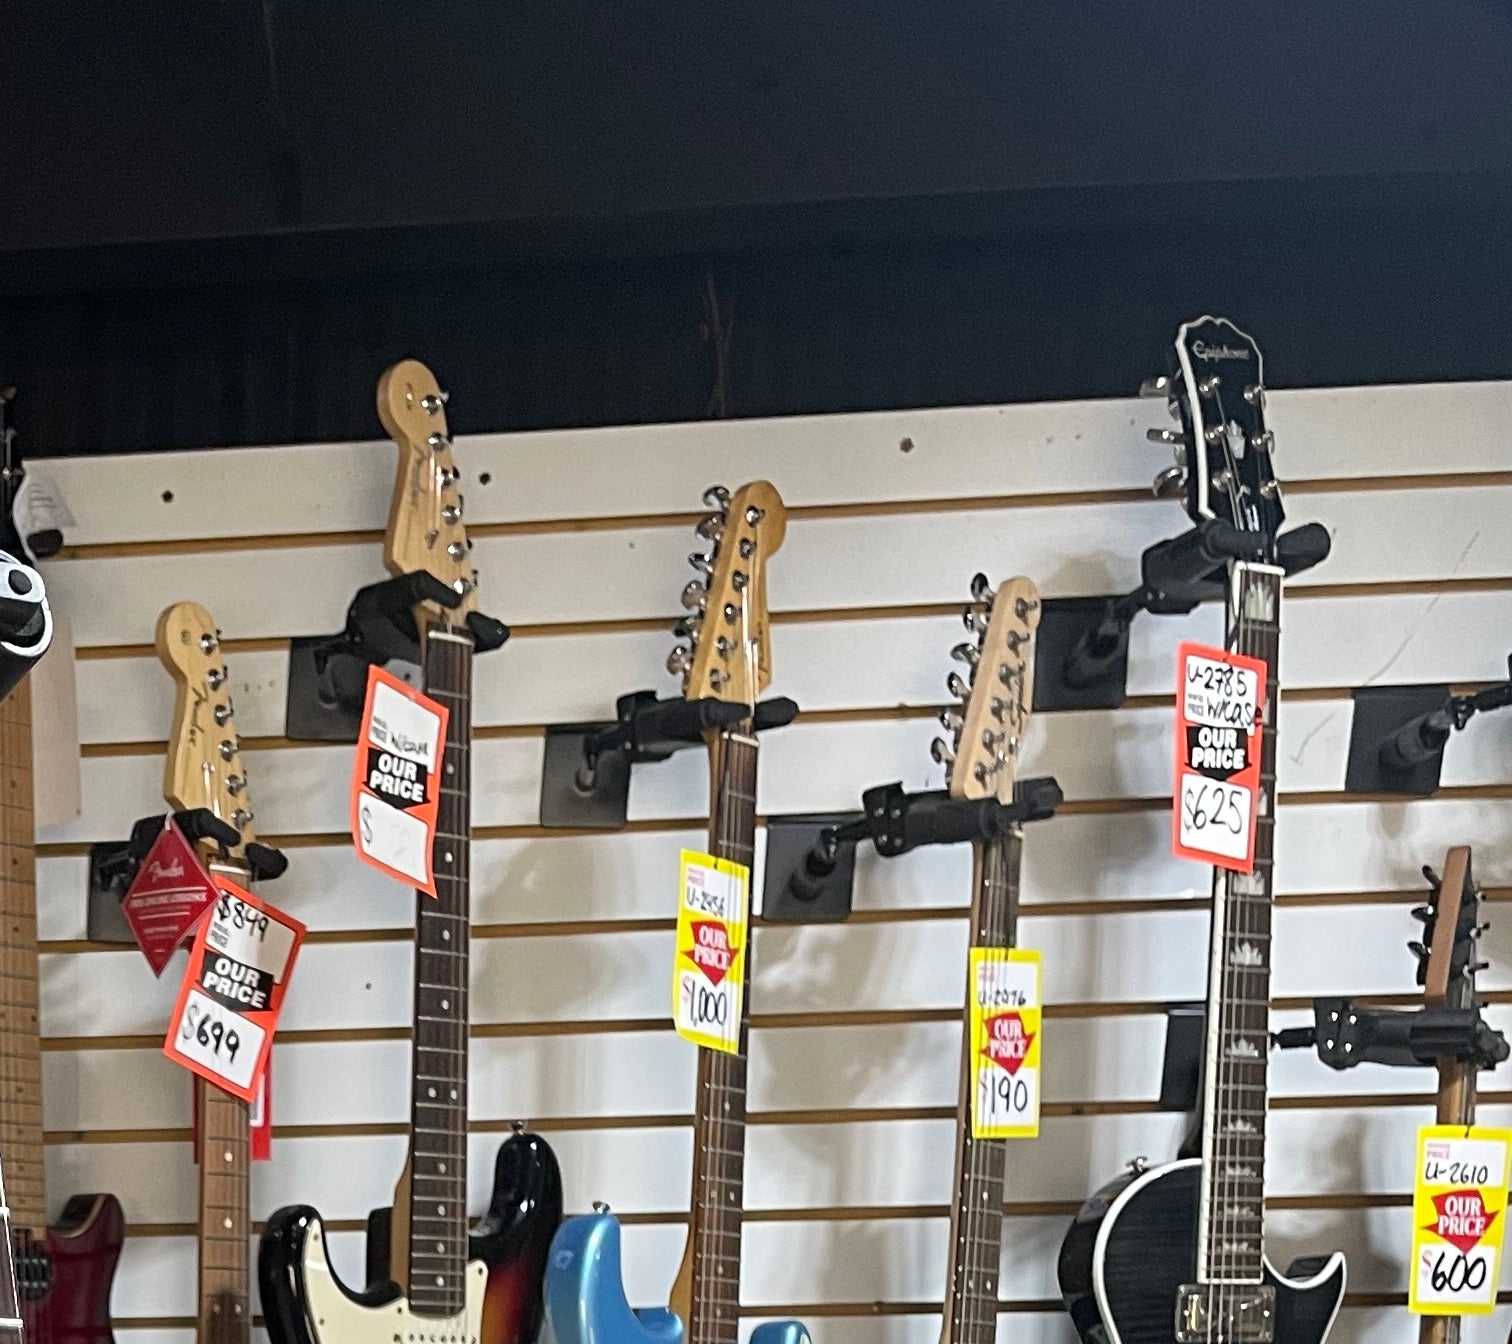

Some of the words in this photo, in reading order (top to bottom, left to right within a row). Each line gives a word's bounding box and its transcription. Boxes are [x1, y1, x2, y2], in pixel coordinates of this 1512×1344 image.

[1197, 726, 1238, 750] OUR
[377, 753, 418, 782] OUR
[1190, 746, 1245, 771] PRICE
[368, 769, 425, 803] PRICE
[698, 924, 728, 949] OUR
[693, 943, 732, 971] PRICE
[214, 958, 260, 987] OUR
[203, 972, 267, 1009] PRICE
[993, 1018, 1023, 1041] OUR
[988, 1039, 1029, 1059] PRICE
[1444, 1195, 1482, 1217] OUR
[1437, 1214, 1487, 1237] PRICE
